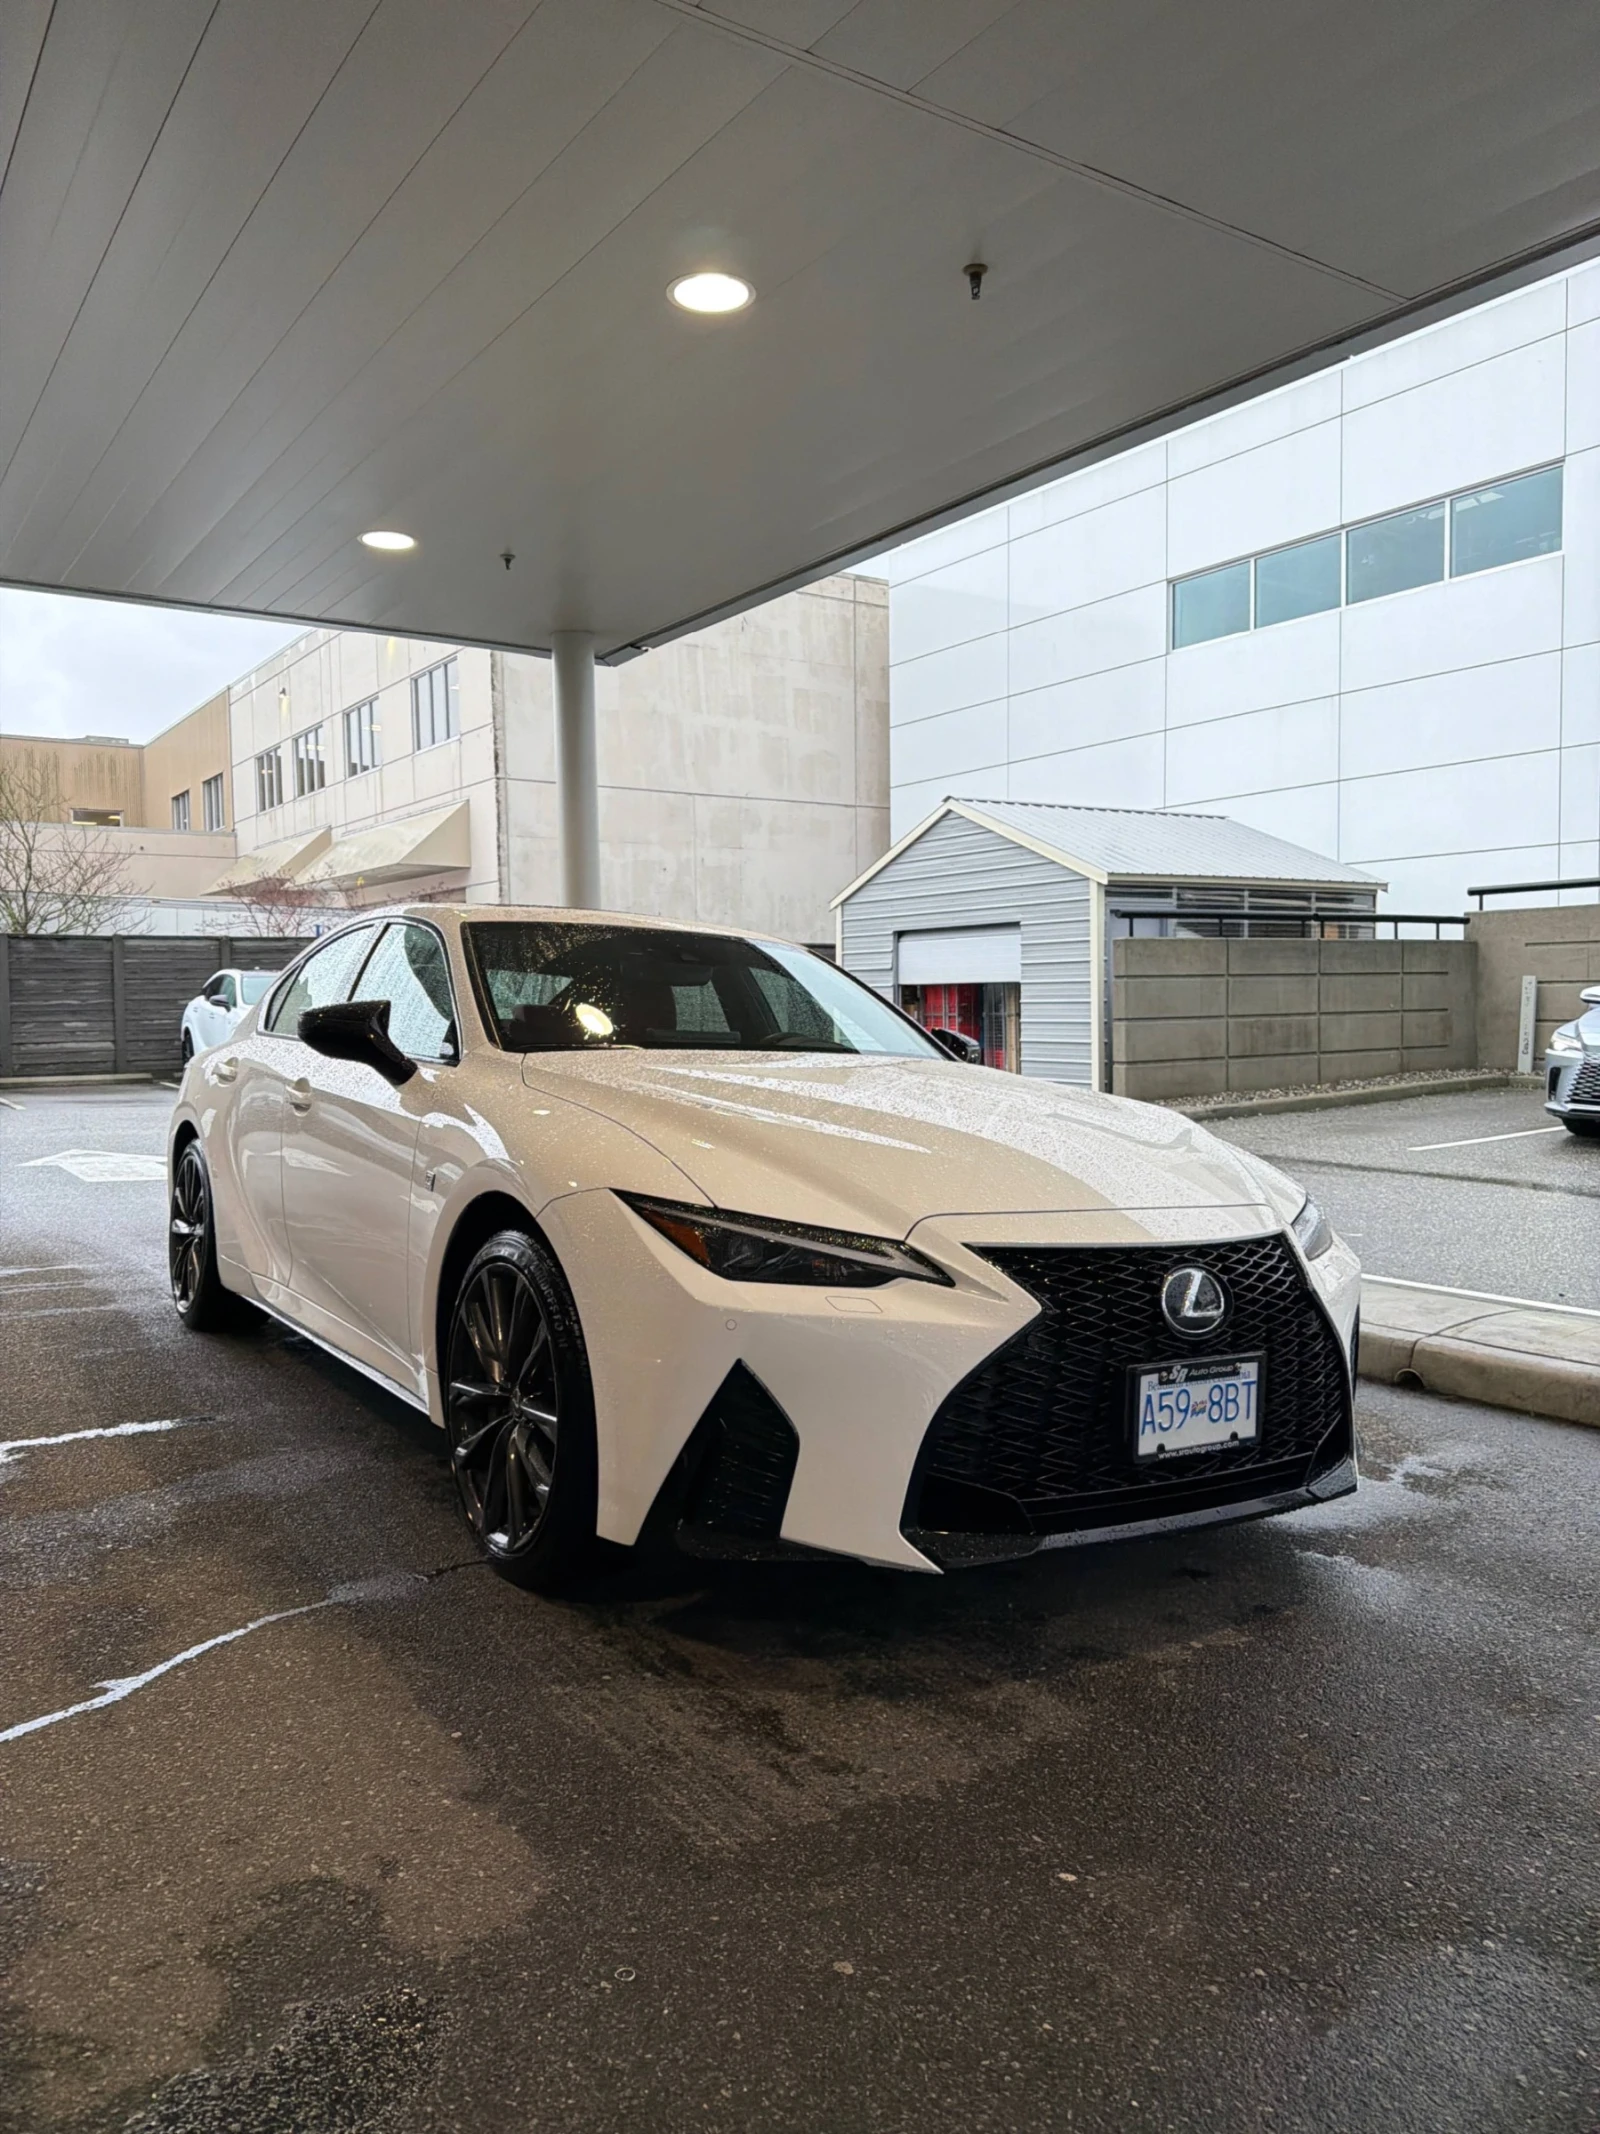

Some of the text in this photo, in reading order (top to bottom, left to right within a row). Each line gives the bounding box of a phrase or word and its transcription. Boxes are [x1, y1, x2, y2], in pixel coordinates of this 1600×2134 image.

[1169, 1365, 1188, 1382] SR
[1189, 1368, 1208, 1376] Auto
[1209, 1365, 1234, 1374] Group
[1141, 1388, 1191, 1436] A59
[1208, 1381, 1257, 1423] 8BT
[1158, 1440, 1240, 1459] www.srautogroup.com
